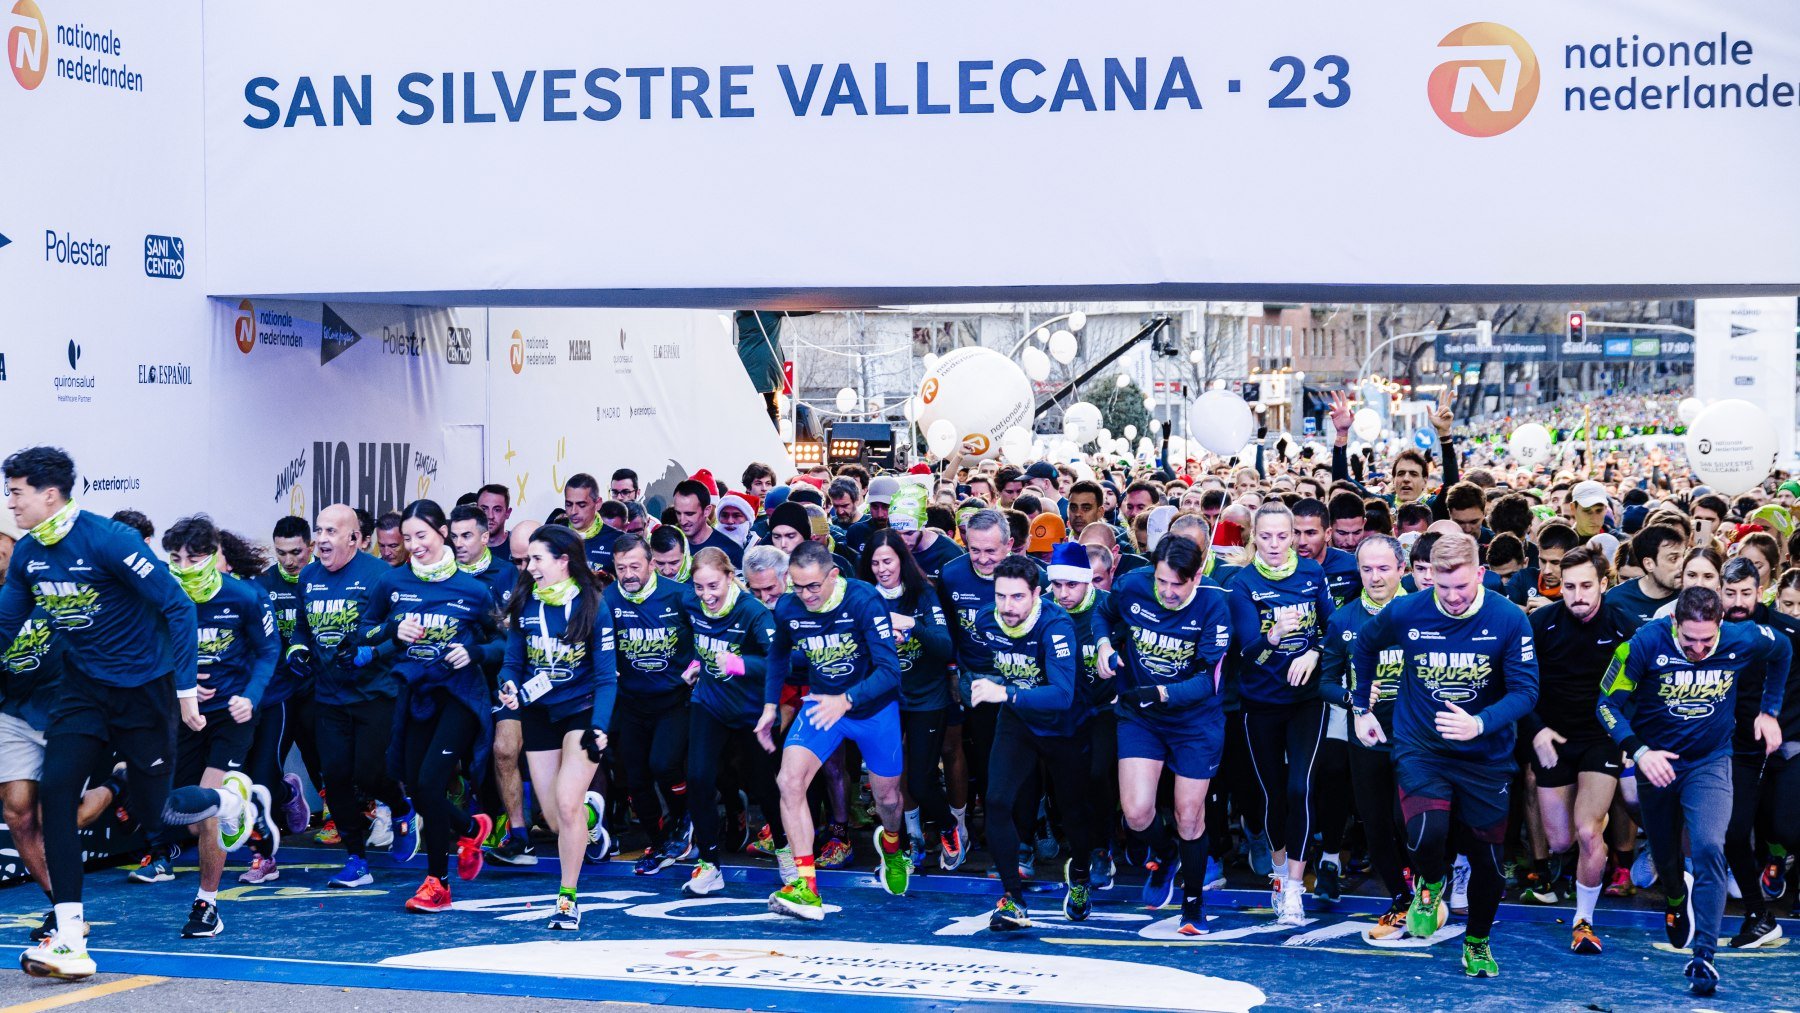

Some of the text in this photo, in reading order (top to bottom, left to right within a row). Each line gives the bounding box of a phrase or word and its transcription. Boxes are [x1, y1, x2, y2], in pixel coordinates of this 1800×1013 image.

[57, 24, 121, 57] nationale
[1565, 31, 1753, 69] nationale
[57, 56, 143, 92] nederlanden
[243, 74, 372, 129] SAN
[396, 65, 755, 125] SILVESTRE
[776, 56, 1203, 117] VALLECANA
[1268, 54, 1352, 109] 23
[1565, 73, 1800, 111] nederlande
[45, 229, 110, 267] Polestar
[146, 238, 169, 257] SANI
[146, 257, 183, 276] CENTRO
[259, 311, 293, 327] nationale
[259, 330, 303, 348] nederlanden
[383, 326, 426, 356] Polestar
[569, 340, 592, 361] MARCA
[138, 362, 193, 385] EL ESPAÑOL
[990, 401, 1022, 434] nationale
[92, 476, 140, 493] exteriorplus
[275, 449, 306, 502] AMIGOS
[359, 442, 410, 520] HAY
[313, 599, 346, 614] NO HAY
[423, 613, 448, 629] HAY
[619, 633, 678, 653] EXCUSAS
[629, 627, 665, 640] NO HAY
[807, 636, 824, 650] NO
[1140, 628, 1182, 650] NO HAY
[1380, 650, 1404, 664] HAY
[1429, 652, 1476, 667] NO HAY
[1417, 662, 1492, 681] EXCUSAS
[1675, 670, 1722, 685] NO HAY
[1658, 677, 1734, 699] EXCUSAS
